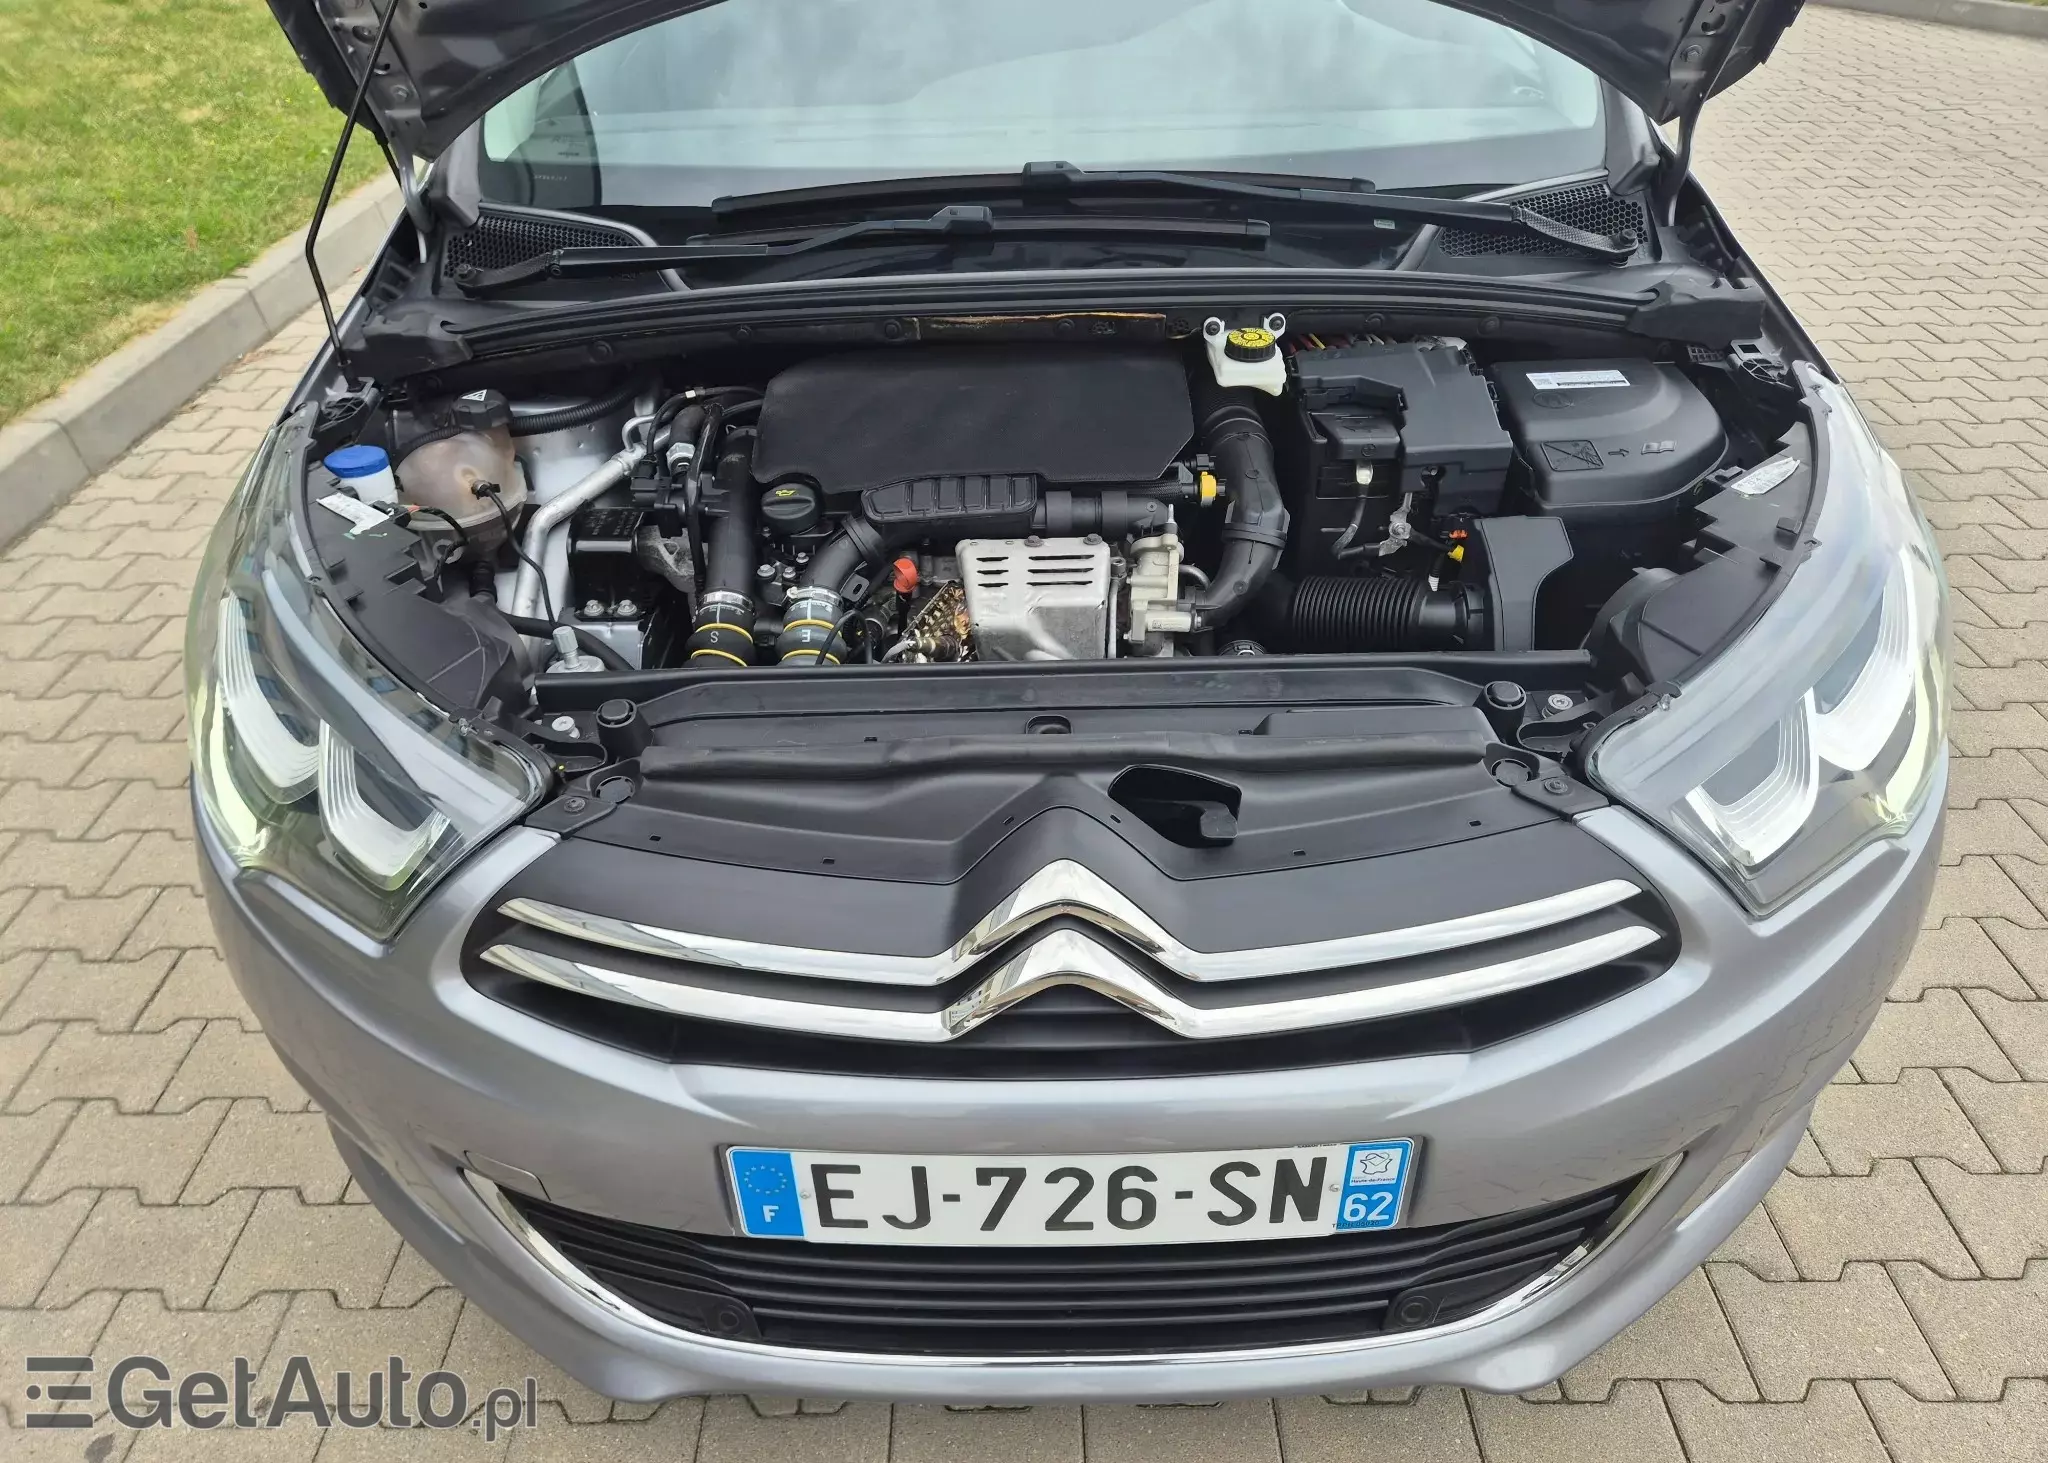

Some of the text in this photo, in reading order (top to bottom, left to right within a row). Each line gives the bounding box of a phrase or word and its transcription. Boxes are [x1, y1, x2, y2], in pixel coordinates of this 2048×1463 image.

[811, 1157, 1327, 1231] EJ-726-SN
[1343, 1191, 1393, 1222] 62
[763, 1205, 779, 1222] F
